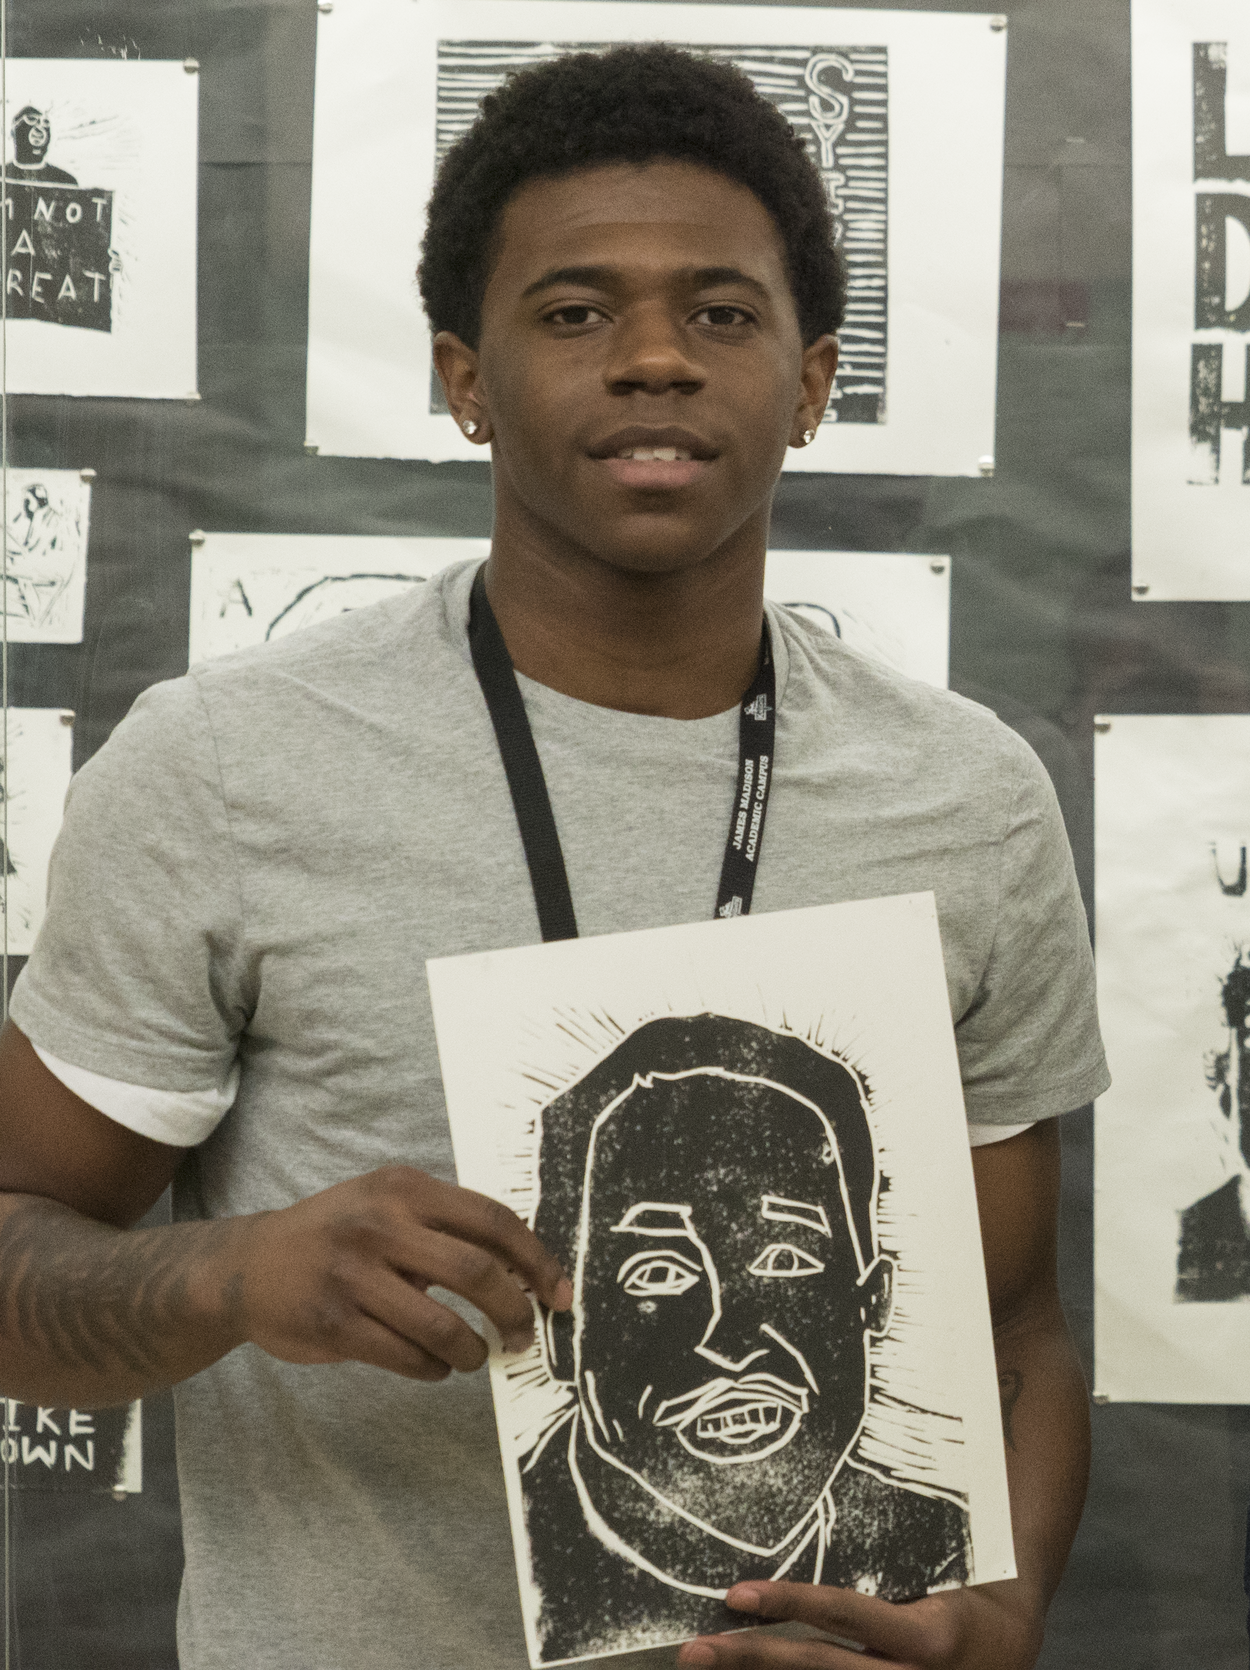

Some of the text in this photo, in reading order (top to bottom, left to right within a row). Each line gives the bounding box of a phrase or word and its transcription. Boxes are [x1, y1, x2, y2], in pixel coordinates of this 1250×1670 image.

[34, 197, 108, 224] NOT
[11, 228, 36, 256] A
[732, 758, 754, 851] JAMES MADISON
[745, 755, 769, 862] ACADEMIC CAMPUS
